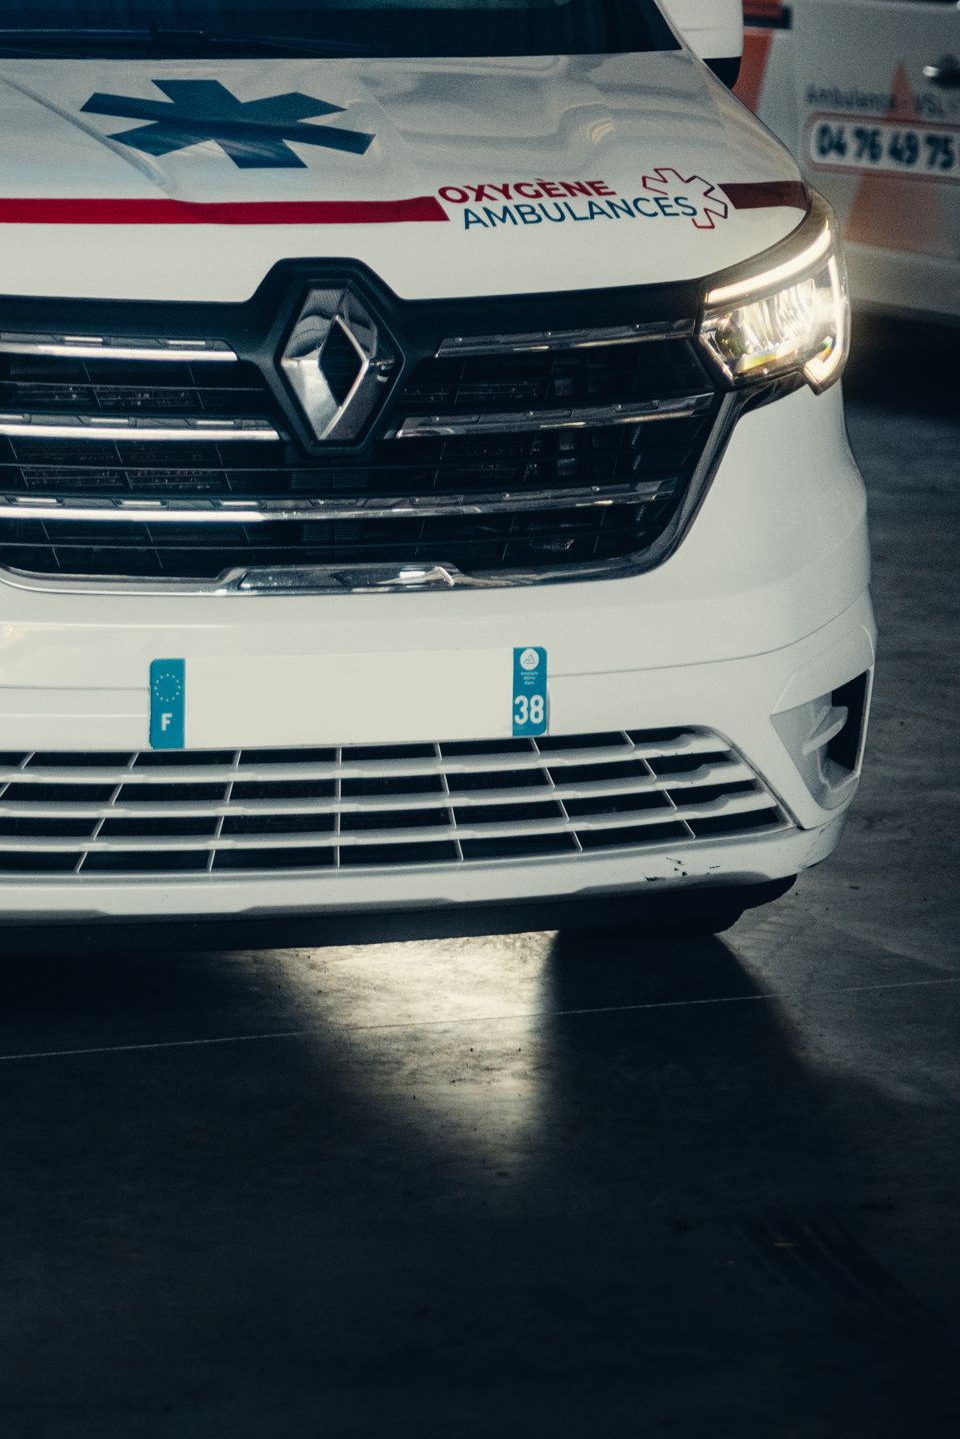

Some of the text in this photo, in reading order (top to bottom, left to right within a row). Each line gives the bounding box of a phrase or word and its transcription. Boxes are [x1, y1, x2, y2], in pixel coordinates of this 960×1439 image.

[816, 122, 955, 170] 04 76 49 75
[438, 178, 617, 204] OXYGÈNE
[464, 196, 698, 230] AMBULANCES
[161, 712, 173, 731] F
[514, 694, 544, 725] 38
